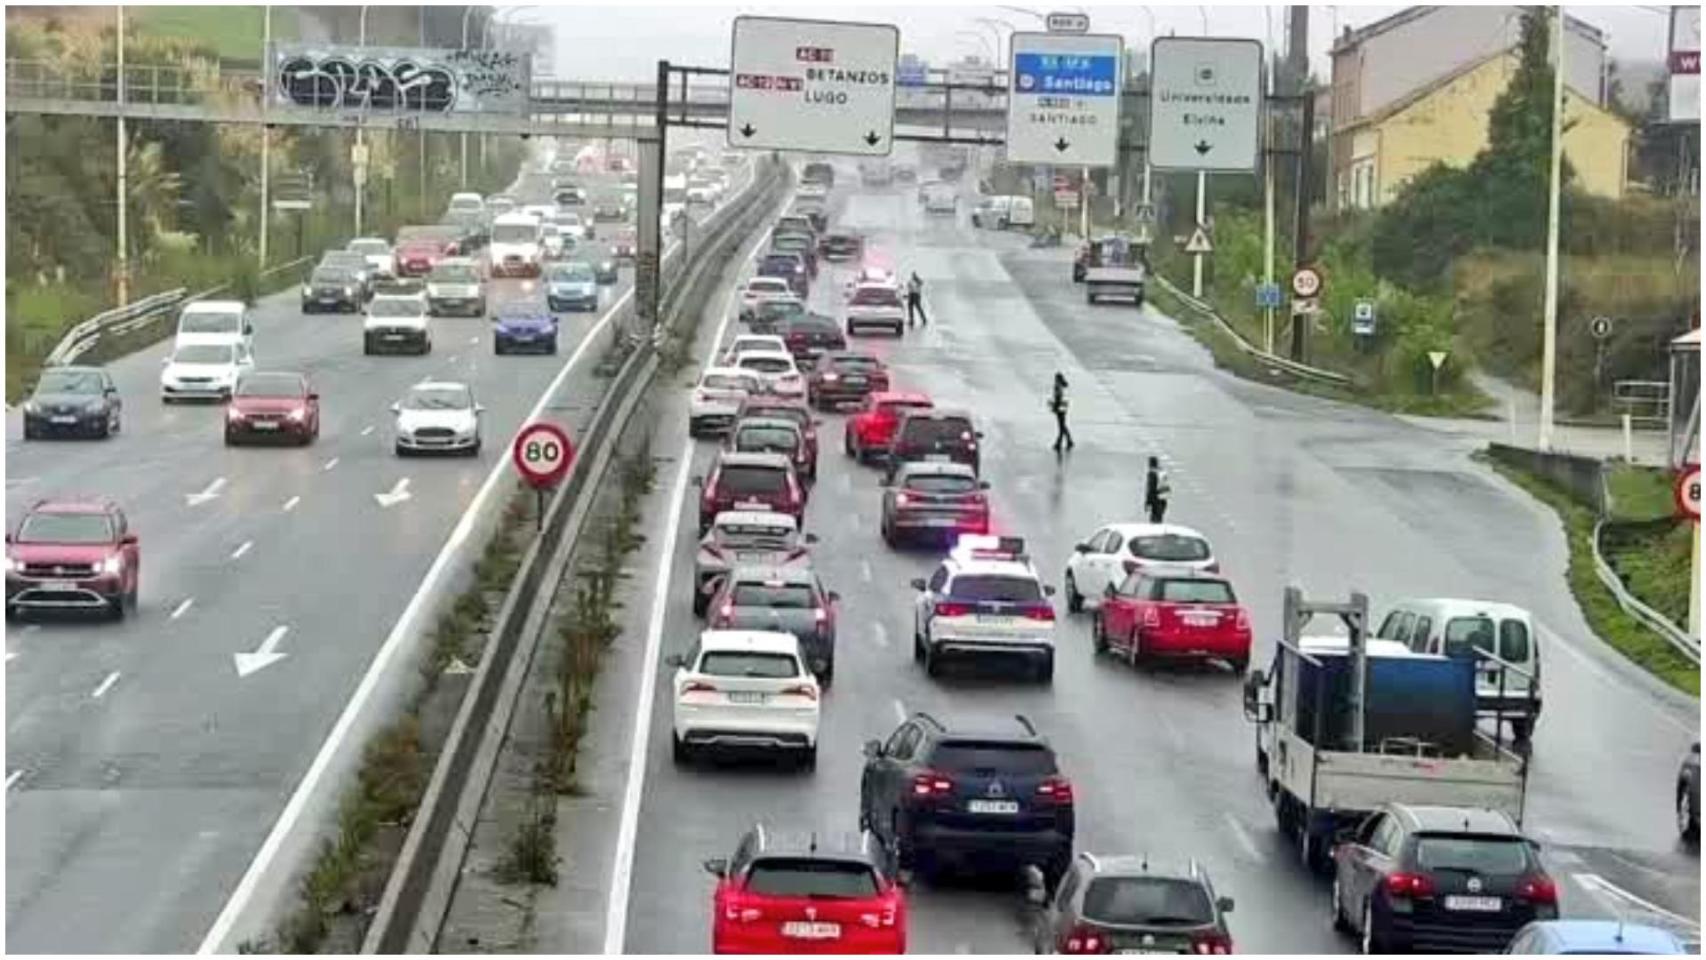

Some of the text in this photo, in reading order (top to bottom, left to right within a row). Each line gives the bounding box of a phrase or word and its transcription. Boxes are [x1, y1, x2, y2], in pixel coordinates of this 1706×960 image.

[806, 68, 889, 84] BETANZOS
[1044, 75, 1112, 92] Santiago
[805, 90, 848, 105] LUGO
[1031, 113, 1097, 124] SANTIAGO
[526, 441, 559, 462] 80
